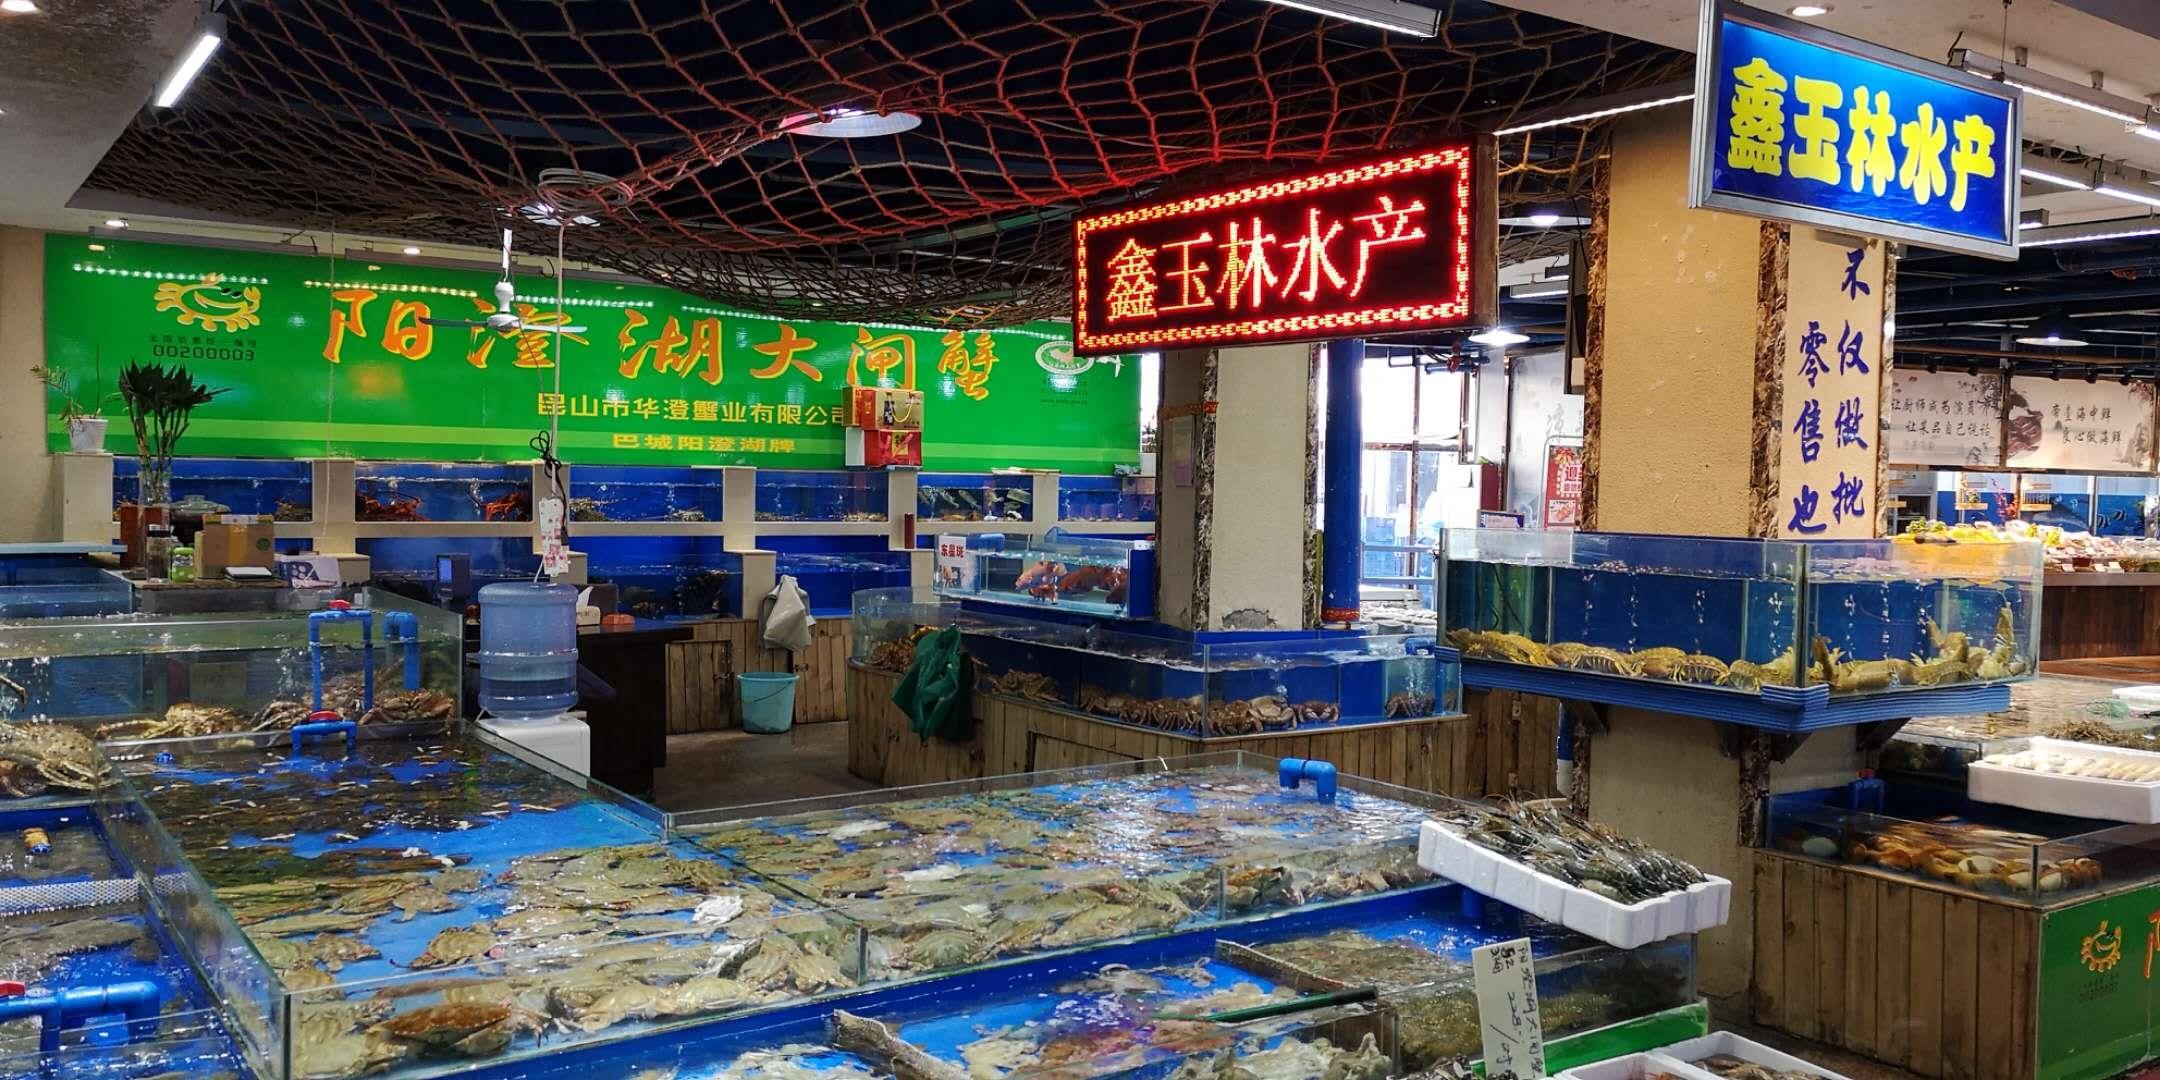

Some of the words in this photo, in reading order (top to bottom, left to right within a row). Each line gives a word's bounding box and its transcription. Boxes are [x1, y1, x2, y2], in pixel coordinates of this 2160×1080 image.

[1728, 57, 1996, 212] 鑫玉林水产
[1106, 196, 1426, 320] 鑫玉林水产
[152, 344, 255, 361] 00200003
[322, 288, 1000, 401] 阳澄湖大闸蟹
[612, 432, 796, 454] 巴城阳澄湖牌
